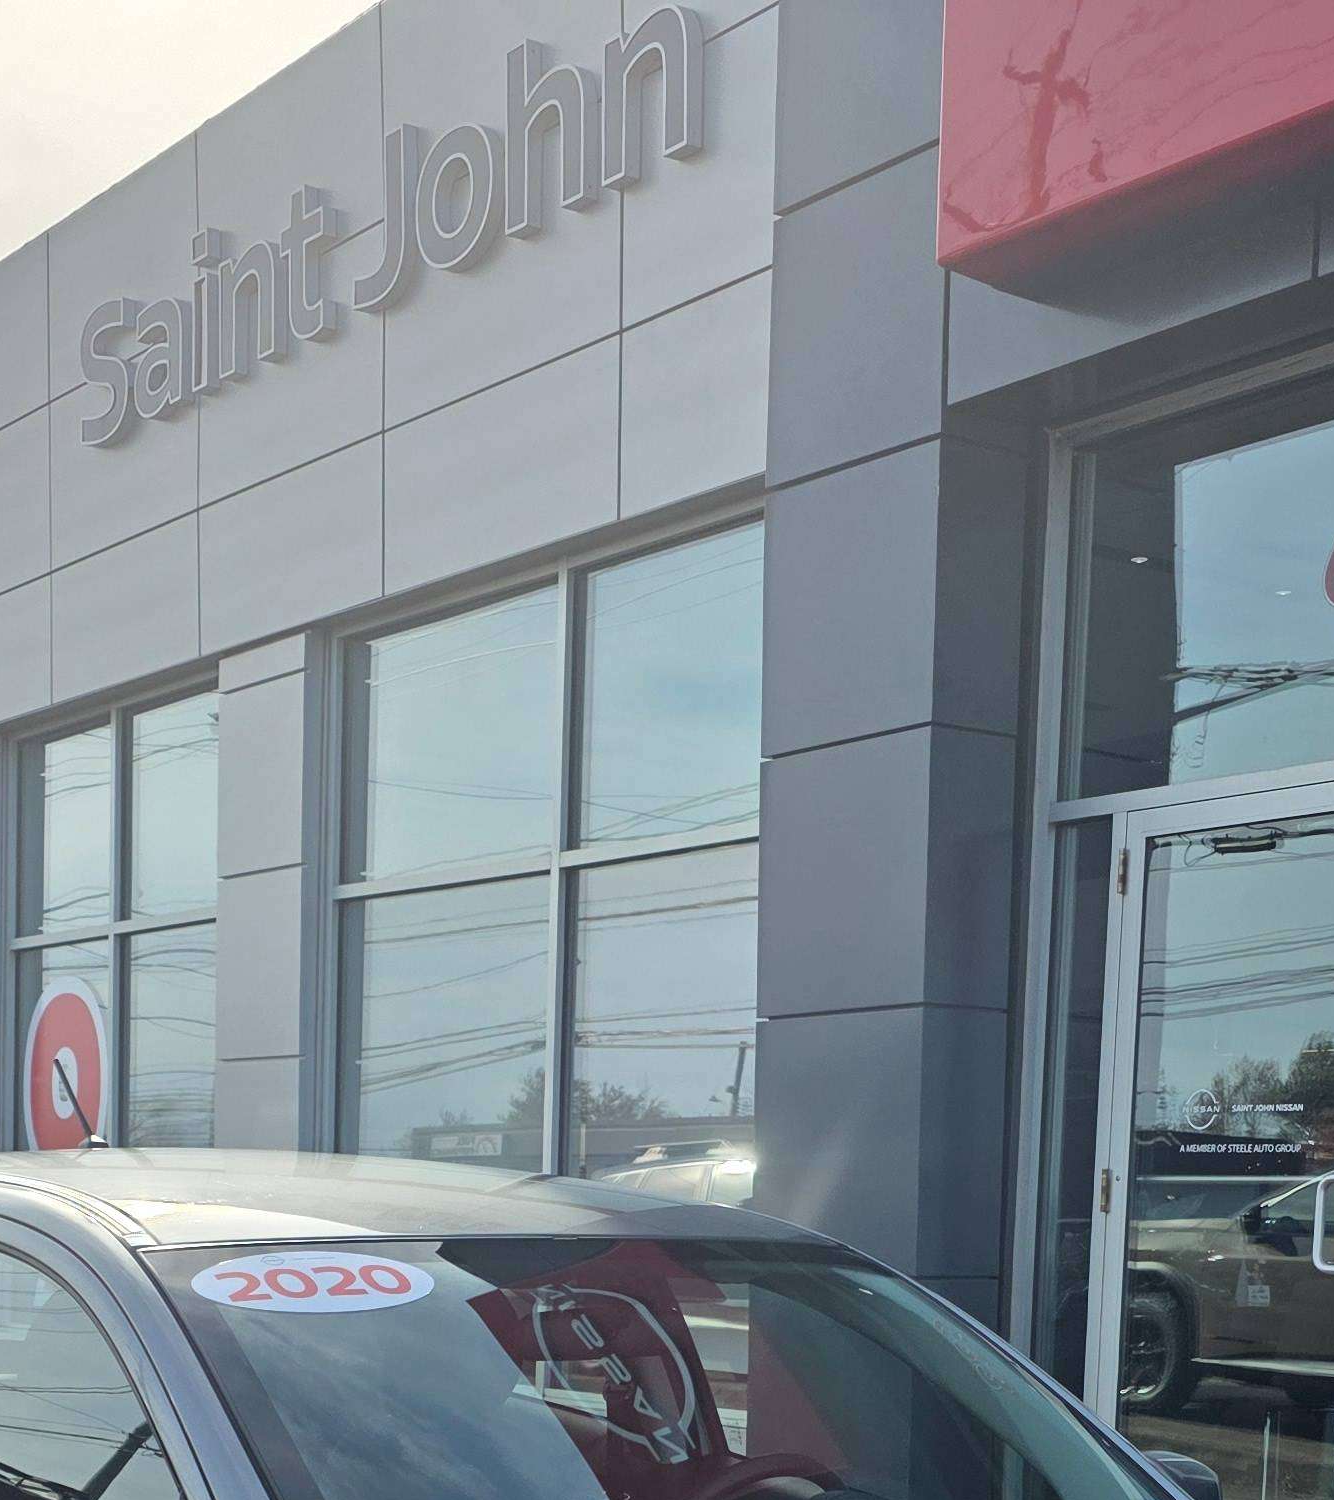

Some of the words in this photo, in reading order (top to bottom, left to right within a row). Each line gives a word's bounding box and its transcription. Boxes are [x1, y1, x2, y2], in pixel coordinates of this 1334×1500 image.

[81, 184, 336, 447] Saint
[353, 6, 704, 312] John
[1182, 1105, 1220, 1113] NISSAN
[1231, 1104, 1254, 1113] SAINT
[1254, 1104, 1275, 1112] JOHN
[1275, 1103, 1304, 1112] NISSAN
[1179, 1144, 1185, 1153] A
[1186, 1144, 1216, 1153] MEMBER
[1217, 1144, 1227, 1153] OF
[1228, 1144, 1252, 1153] STEELE
[1253, 1144, 1274, 1153] AUTO
[215, 1264, 412, 1303] 2020
